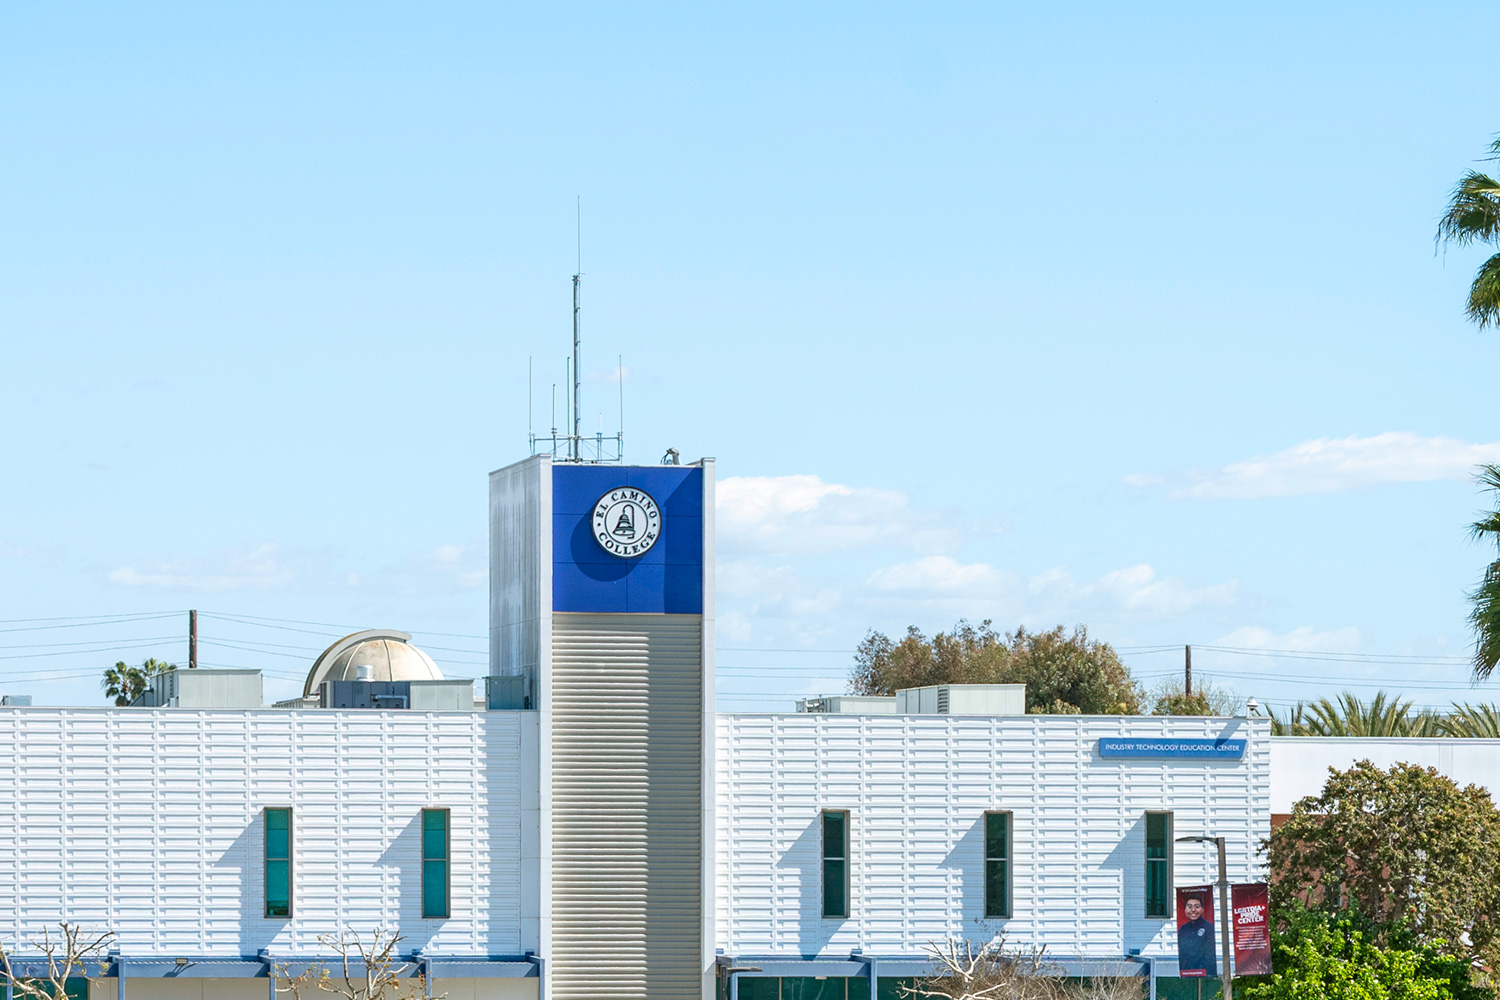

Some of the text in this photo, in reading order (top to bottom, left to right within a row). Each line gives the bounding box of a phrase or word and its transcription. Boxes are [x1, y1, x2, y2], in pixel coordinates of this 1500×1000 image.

[596, 491, 658, 518] EL CAMINO
[599, 532, 656, 555] COLLEGE
[1105, 743, 1240, 752] INDUSTRY TECHNOLOGY EDUCATION CENTER
[1237, 915, 1264, 925] CENTER
